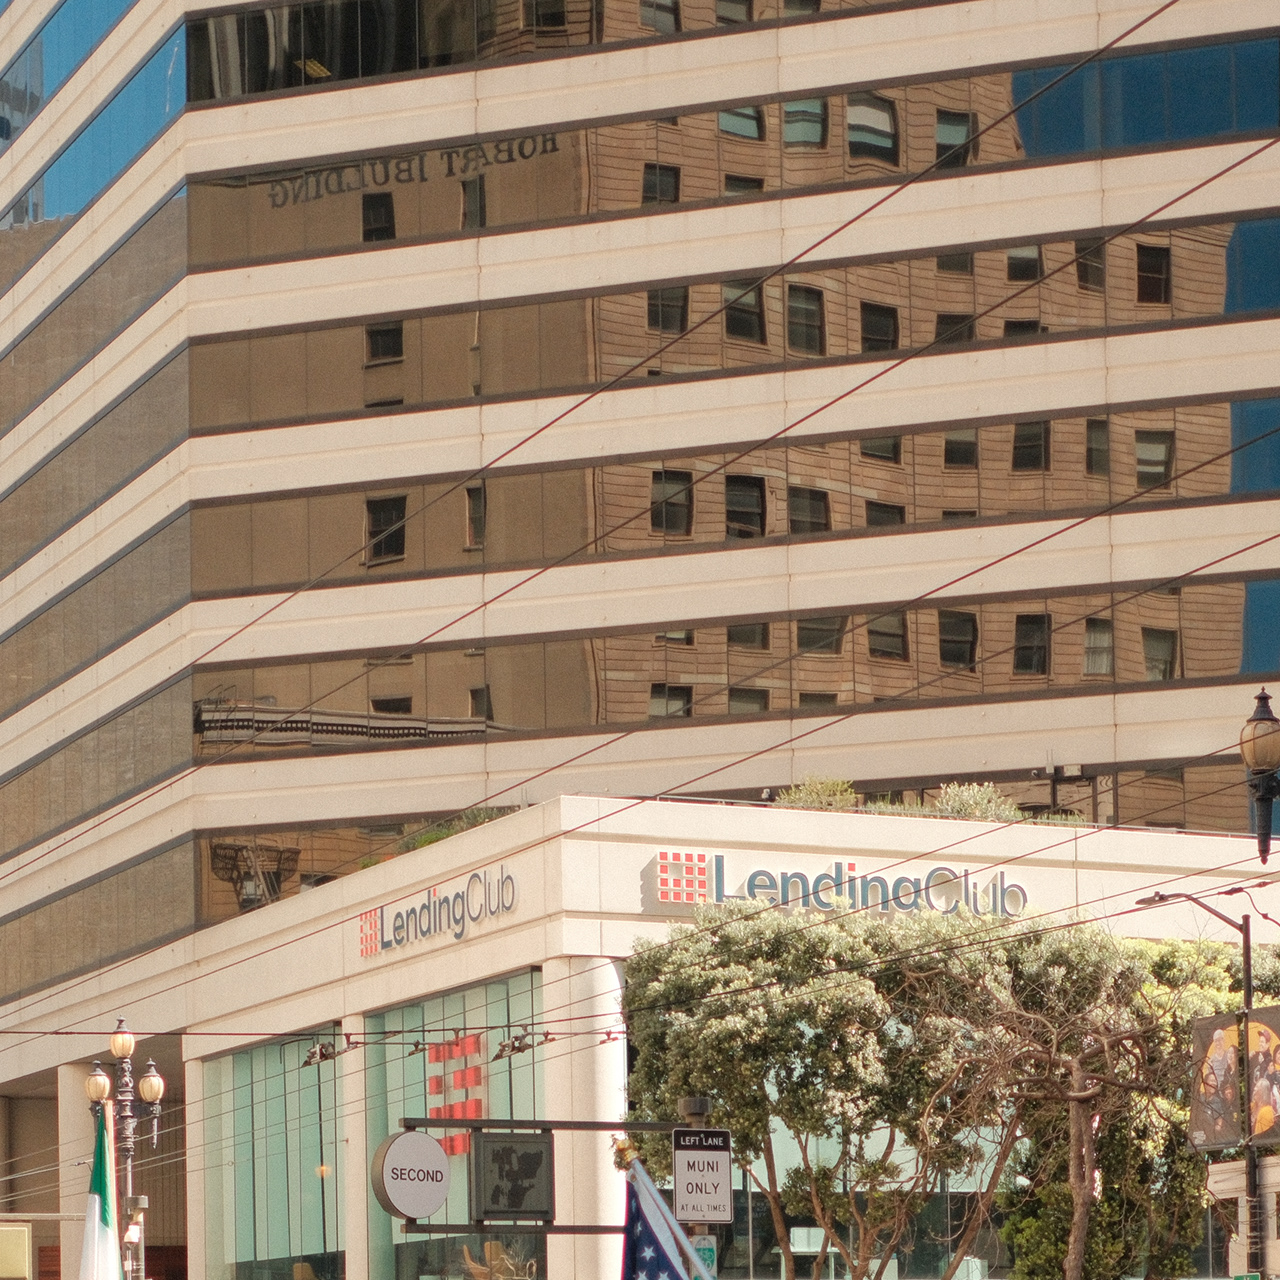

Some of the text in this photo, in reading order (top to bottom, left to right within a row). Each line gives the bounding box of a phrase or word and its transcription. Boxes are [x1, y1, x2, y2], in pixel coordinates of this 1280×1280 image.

[714, 855, 1028, 917] LendingClub
[380, 864, 515, 950] LendingClub
[681, 1137, 724, 1146] LEFT LANE
[687, 1160, 719, 1172] MUNI
[391, 1167, 444, 1183] SECOND
[686, 1182, 720, 1194] ONLY
[707, 1204, 726, 1212] TIMES
